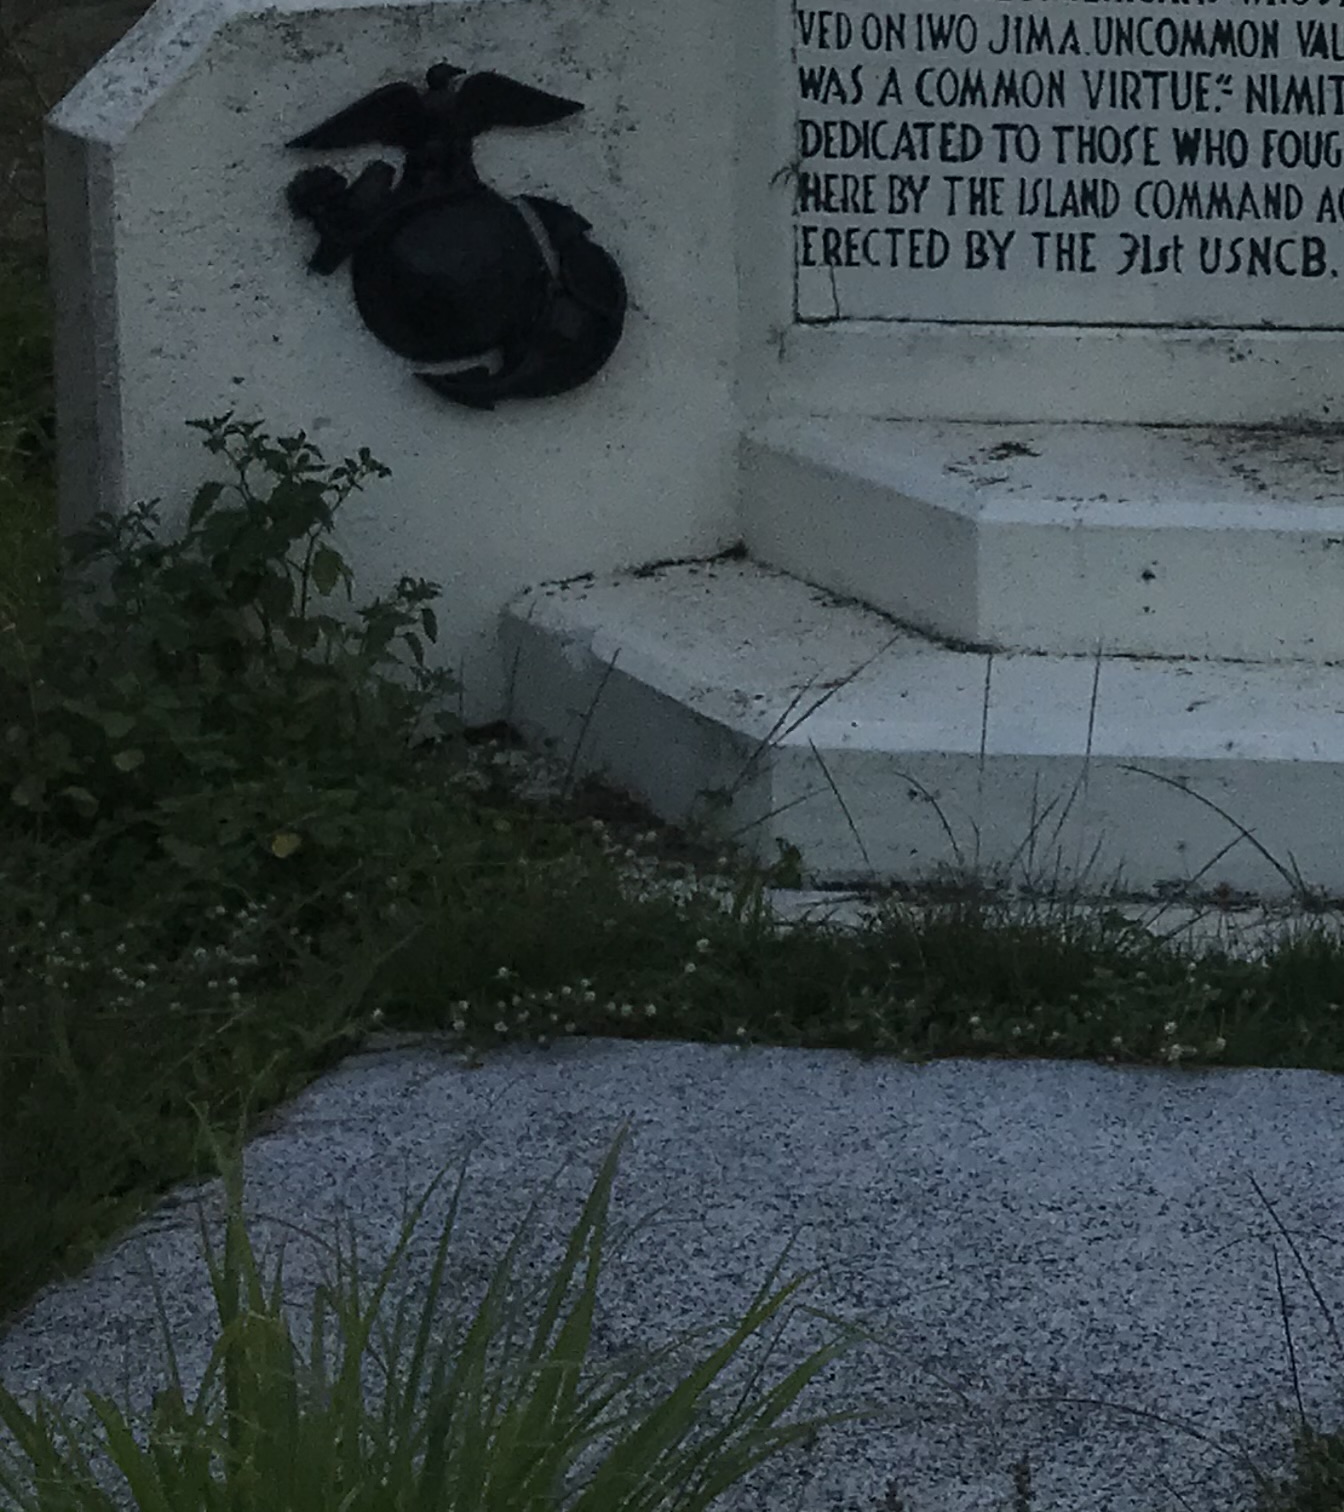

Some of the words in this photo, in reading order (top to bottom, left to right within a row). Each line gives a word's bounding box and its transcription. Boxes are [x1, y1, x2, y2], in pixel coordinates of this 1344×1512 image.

[796, 9, 852, 50] VED
[862, 13, 905, 51] ON
[917, 13, 977, 54] IWO
[1094, 17, 1279, 58] UNCOMMON
[799, 65, 863, 105] WAS
[877, 67, 902, 106] A
[915, 68, 1064, 108] COMMON
[796, 119, 983, 163] DEDICATED
[992, 123, 1040, 163] TO
[1052, 125, 1160, 166] THOSE
[1173, 128, 1248, 168] WHO
[796, 170, 876, 214] HERE
[888, 174, 930, 214] BY
[943, 176, 1004, 216] THE
[1018, 178, 1119, 218] ISLAND
[1135, 180, 1303, 221] COMMAND
[801, 226, 949, 269] ERECTED
[965, 230, 1015, 270] BY
[1031, 232, 1096, 273] THE
[1116, 233, 1184, 275] 31st
[1200, 236, 1338, 277] USNCB.
